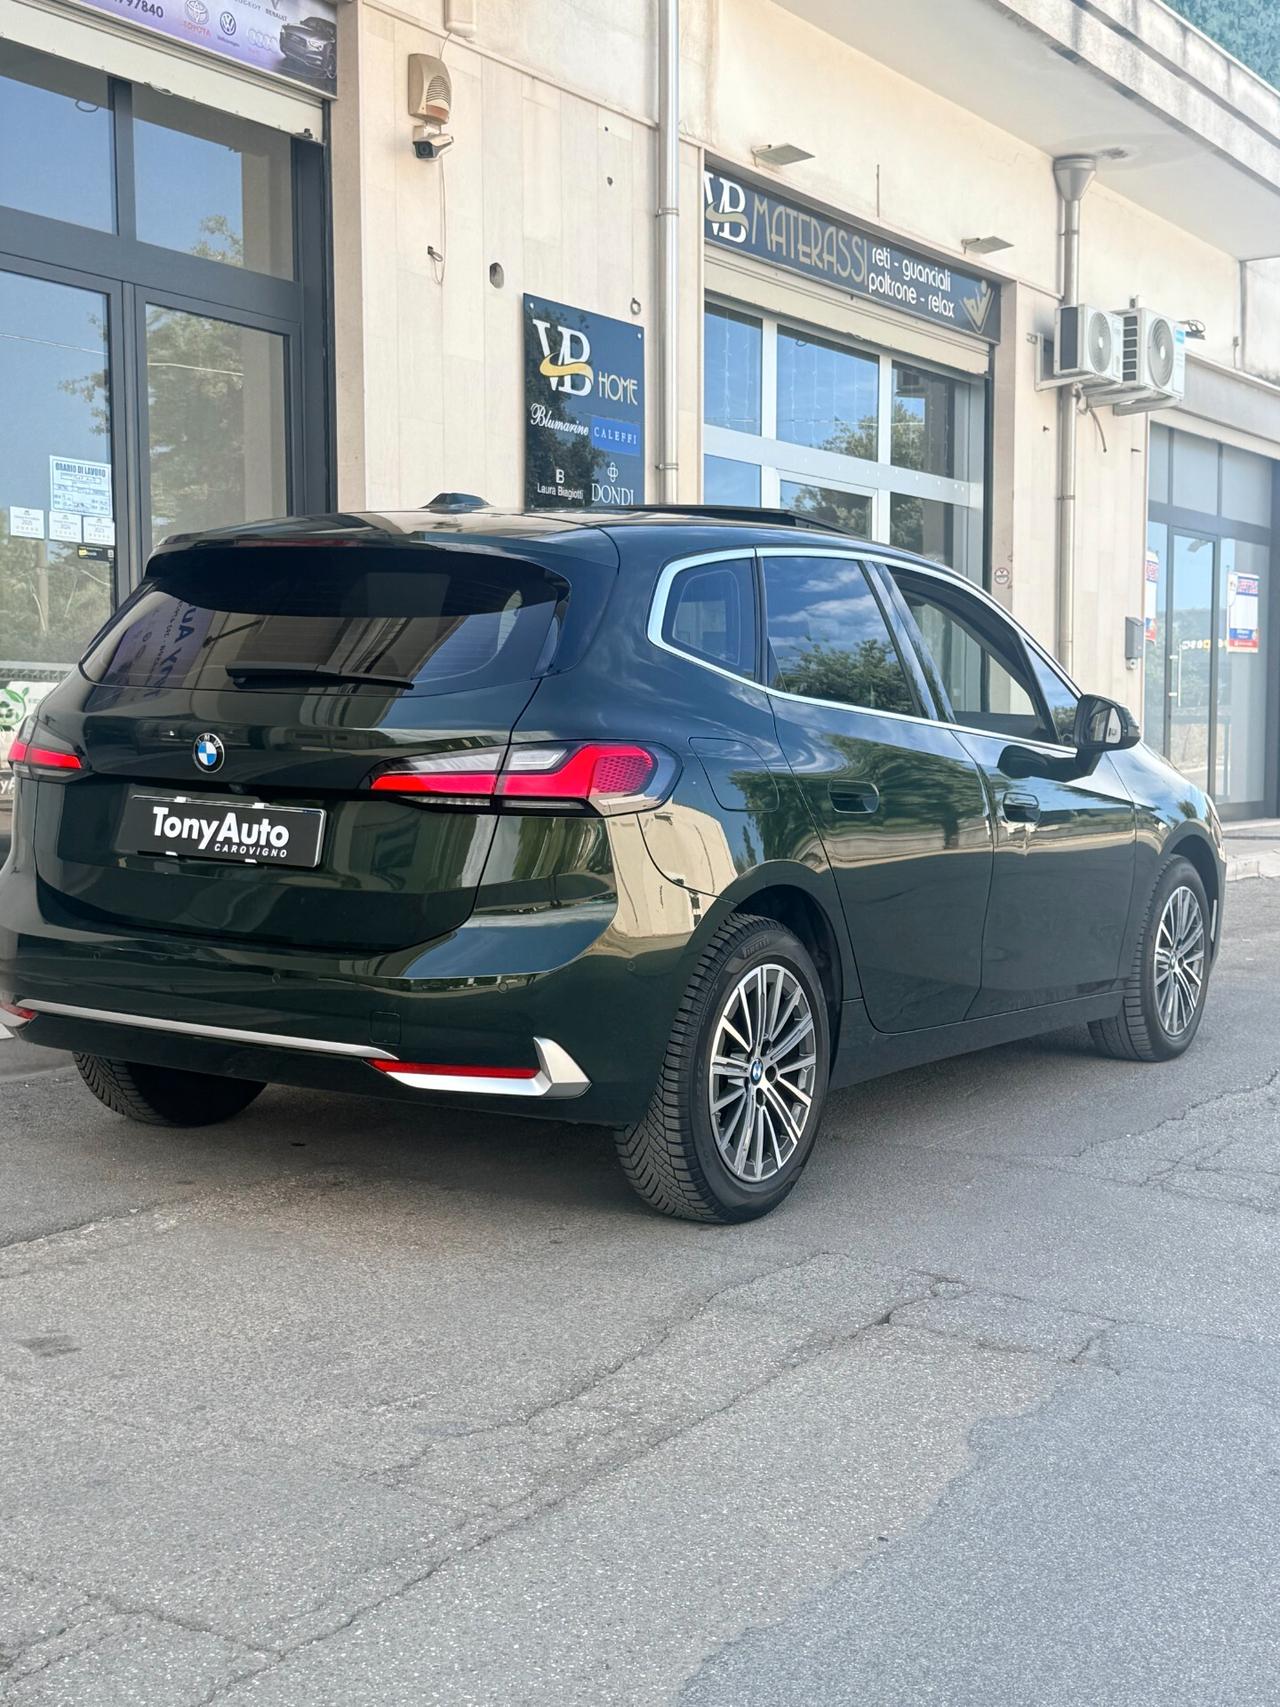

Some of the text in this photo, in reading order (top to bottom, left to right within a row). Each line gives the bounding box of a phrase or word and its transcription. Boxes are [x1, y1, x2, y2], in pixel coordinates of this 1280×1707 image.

[751, 193, 868, 286] MATERASSI
[872, 247, 890, 269] reti
[903, 258, 951, 293] guanciali
[869, 272, 917, 305] poltrone
[928, 291, 955, 318] relax
[598, 371, 638, 405] HOME
[530, 403, 589, 436] Blumarine
[593, 426, 637, 445] CALEFFI
[55, 462, 106, 478] ORARIO DI LAVORO
[537, 483, 584, 501] Laura Biagiotti
[591, 483, 634, 506] DONDI
[153, 806, 290, 850] TonyAuto
[214, 843, 288, 858] CAROVIGNO
